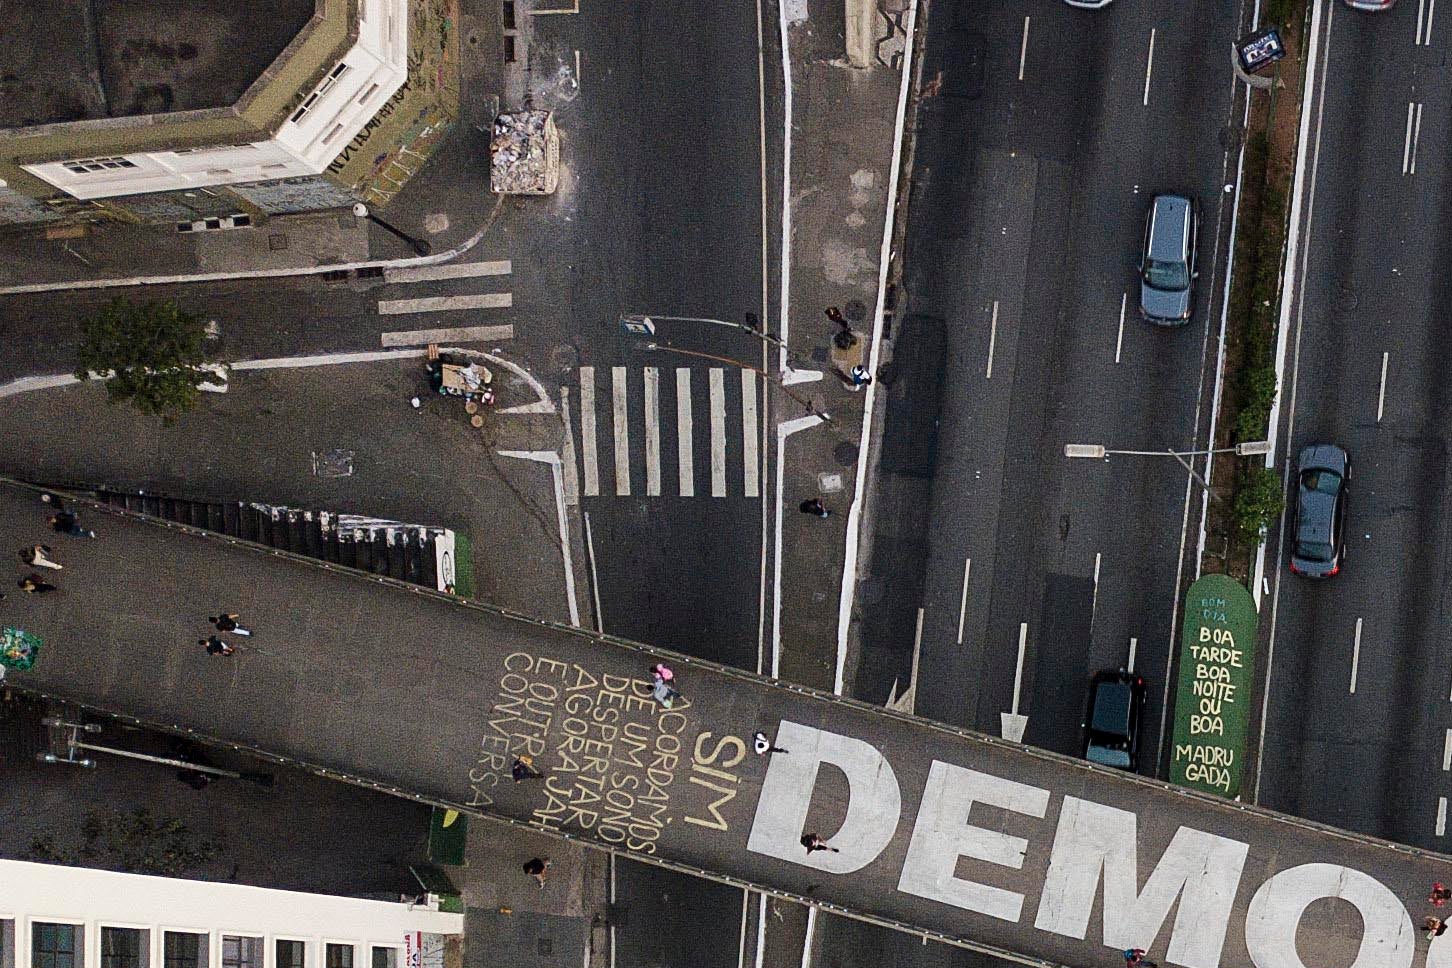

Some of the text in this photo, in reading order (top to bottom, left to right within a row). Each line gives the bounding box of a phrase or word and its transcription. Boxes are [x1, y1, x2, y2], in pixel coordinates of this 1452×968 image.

[1201, 598, 1225, 607] BOM
[1199, 626, 1235, 648] BOA
[1190, 645, 1243, 668] TARDE
[1196, 663, 1231, 683] BOA
[1193, 679, 1236, 703] NOITE
[1199, 698, 1221, 715] OU
[465, 652, 534, 807] CONVERSA
[1190, 714, 1223, 736] BOA
[528, 663, 599, 831] AGORA JAH
[562, 673, 630, 830] DESPERTAR
[1176, 744, 1233, 767] MADRU
[597, 677, 657, 843] DE UM SONO
[626, 697, 694, 854] ACORDAMOS
[684, 730, 746, 831] SIM
[1185, 763, 1231, 792] GADA
